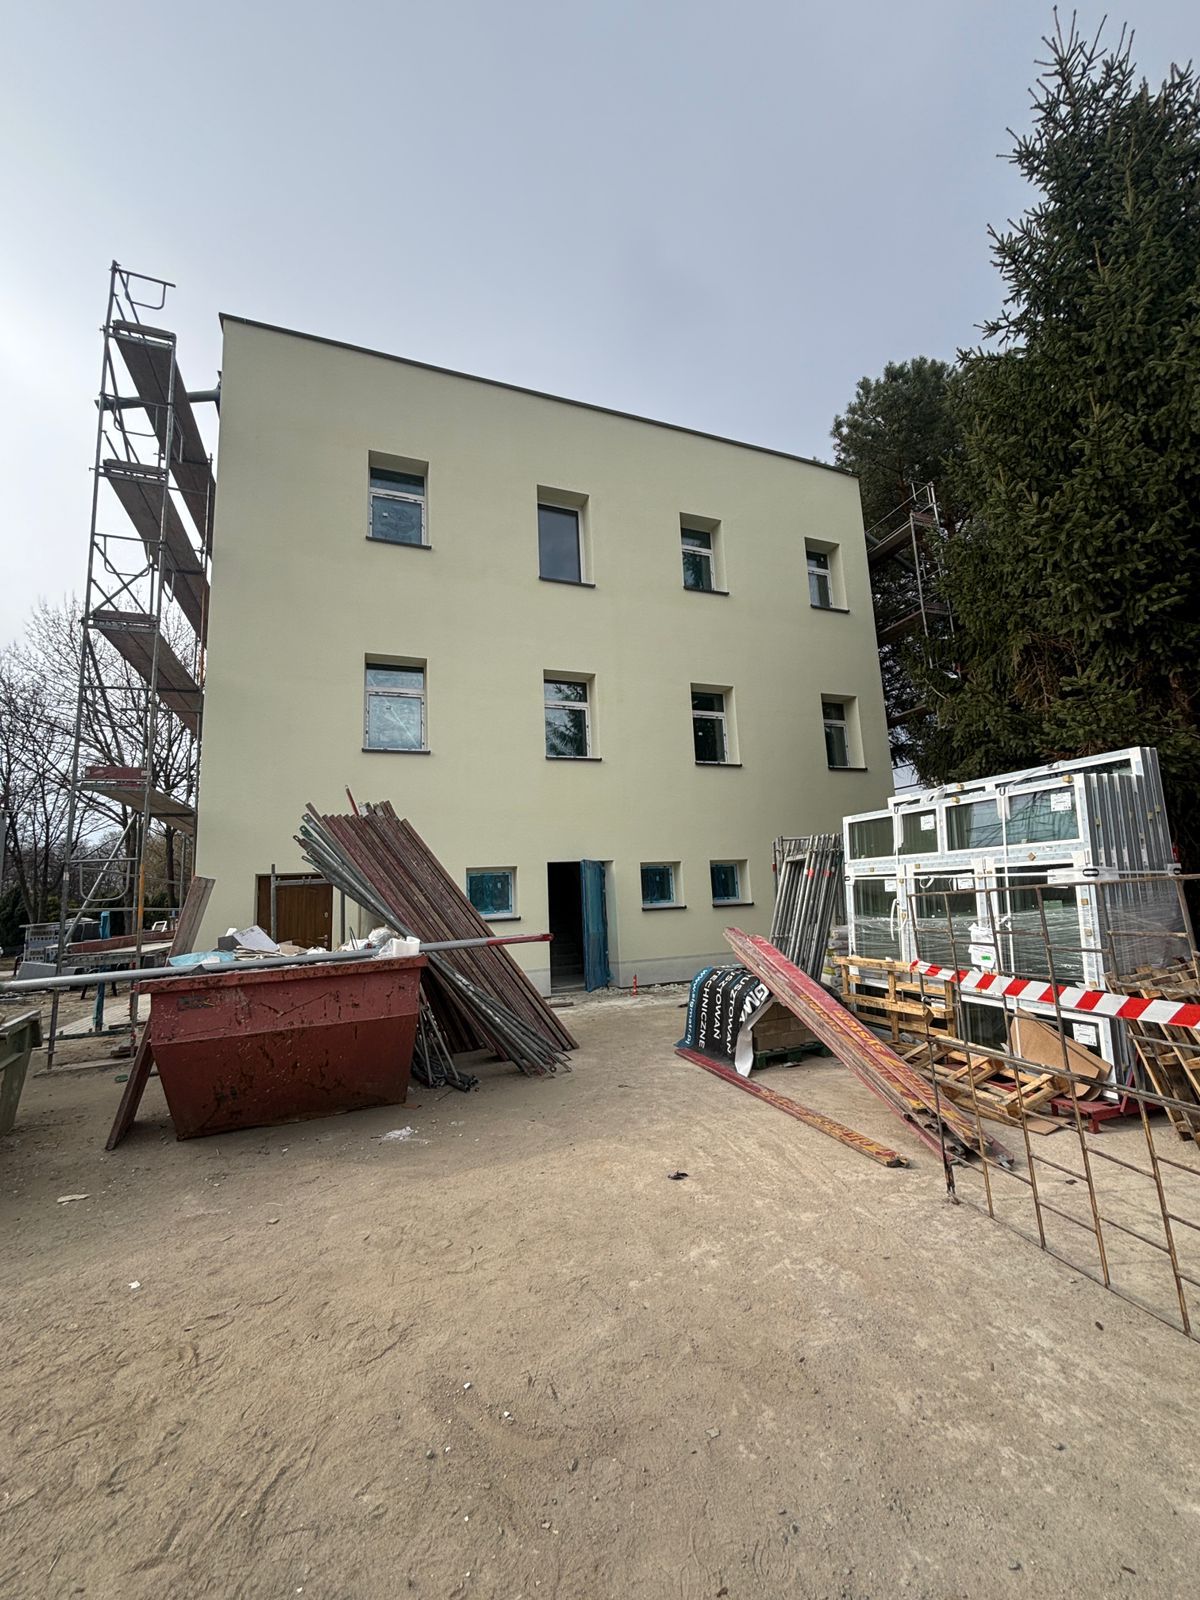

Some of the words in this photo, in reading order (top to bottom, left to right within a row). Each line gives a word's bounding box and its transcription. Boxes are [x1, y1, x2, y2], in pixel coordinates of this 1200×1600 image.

[698, 970, 724, 1049] TECHNICZNE
[739, 983, 770, 1023] GMA
[832, 1008, 886, 1053] system
